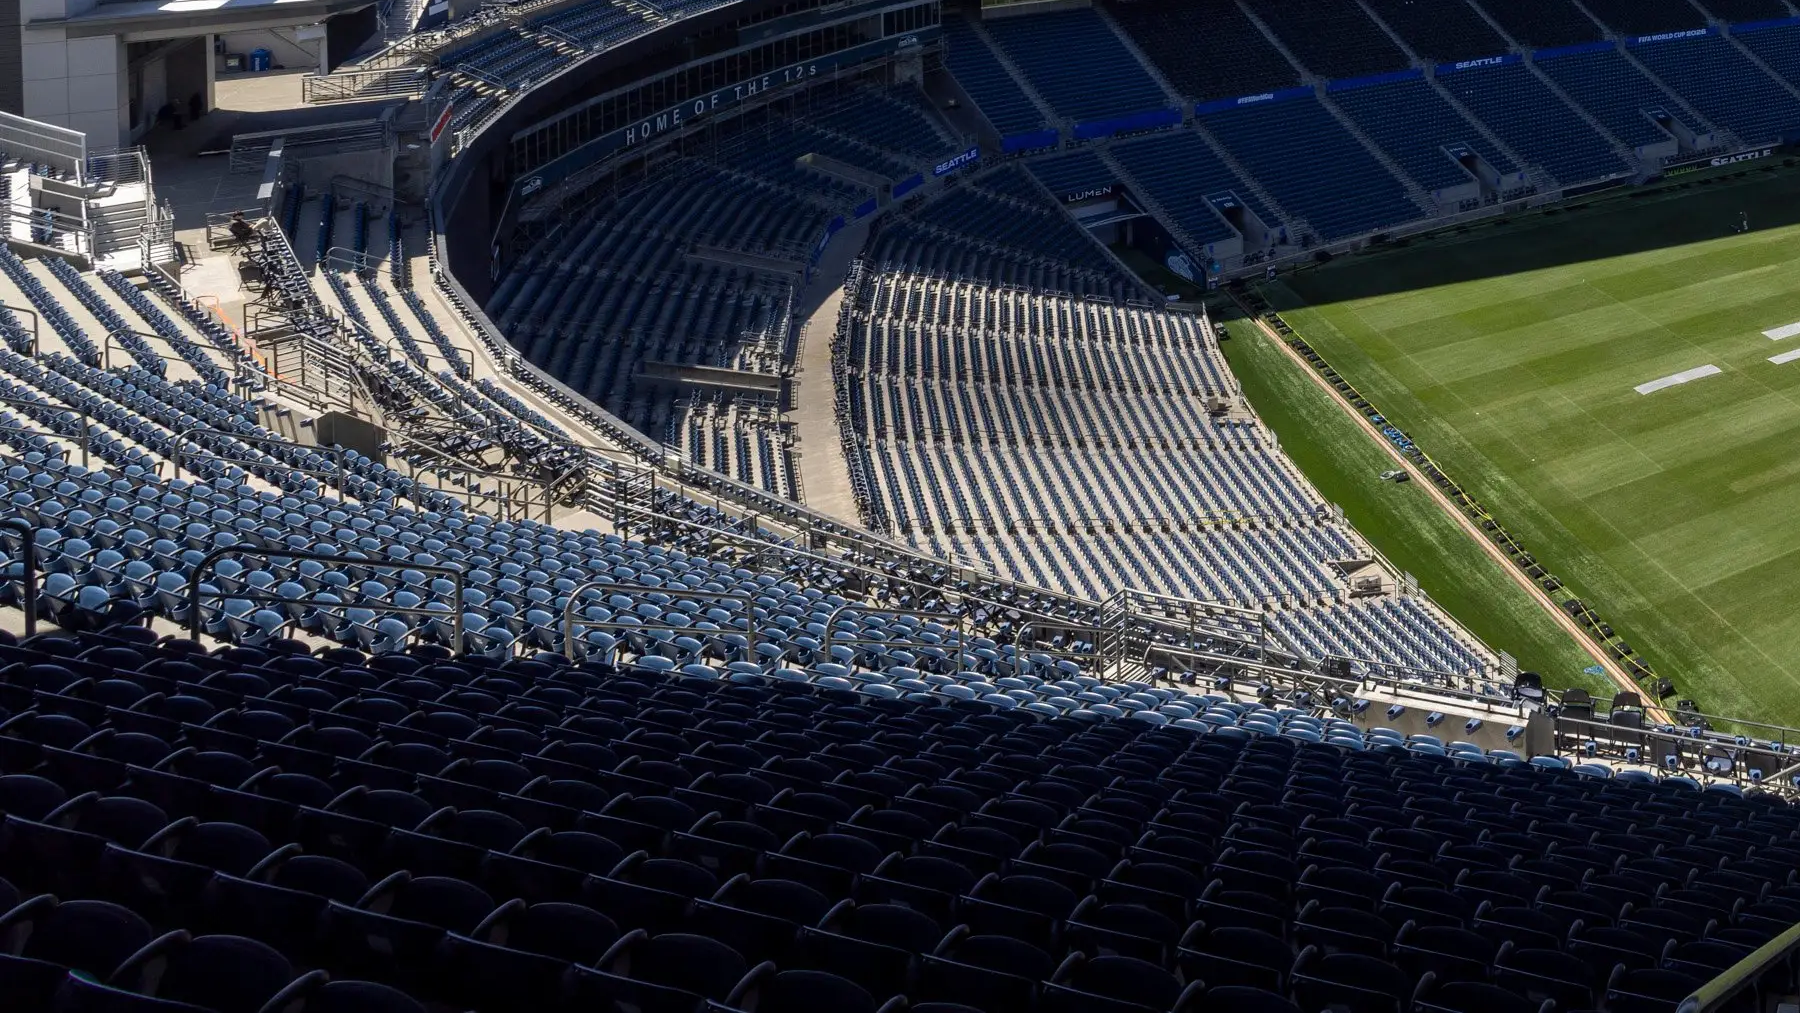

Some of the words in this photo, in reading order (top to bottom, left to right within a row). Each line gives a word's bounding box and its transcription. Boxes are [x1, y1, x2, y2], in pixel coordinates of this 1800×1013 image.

[1686, 28, 1706, 36] 2026
[1456, 56, 1503, 69] SEATTLE
[626, 110, 680, 146] HOME
[694, 94, 719, 115] OF
[734, 77, 770, 100] THE
[784, 64, 816, 82] 12s
[935, 148, 977, 173] SEATTLE
[1711, 149, 1774, 167] SEATTLE
[1068, 186, 1112, 202] LUMEN
